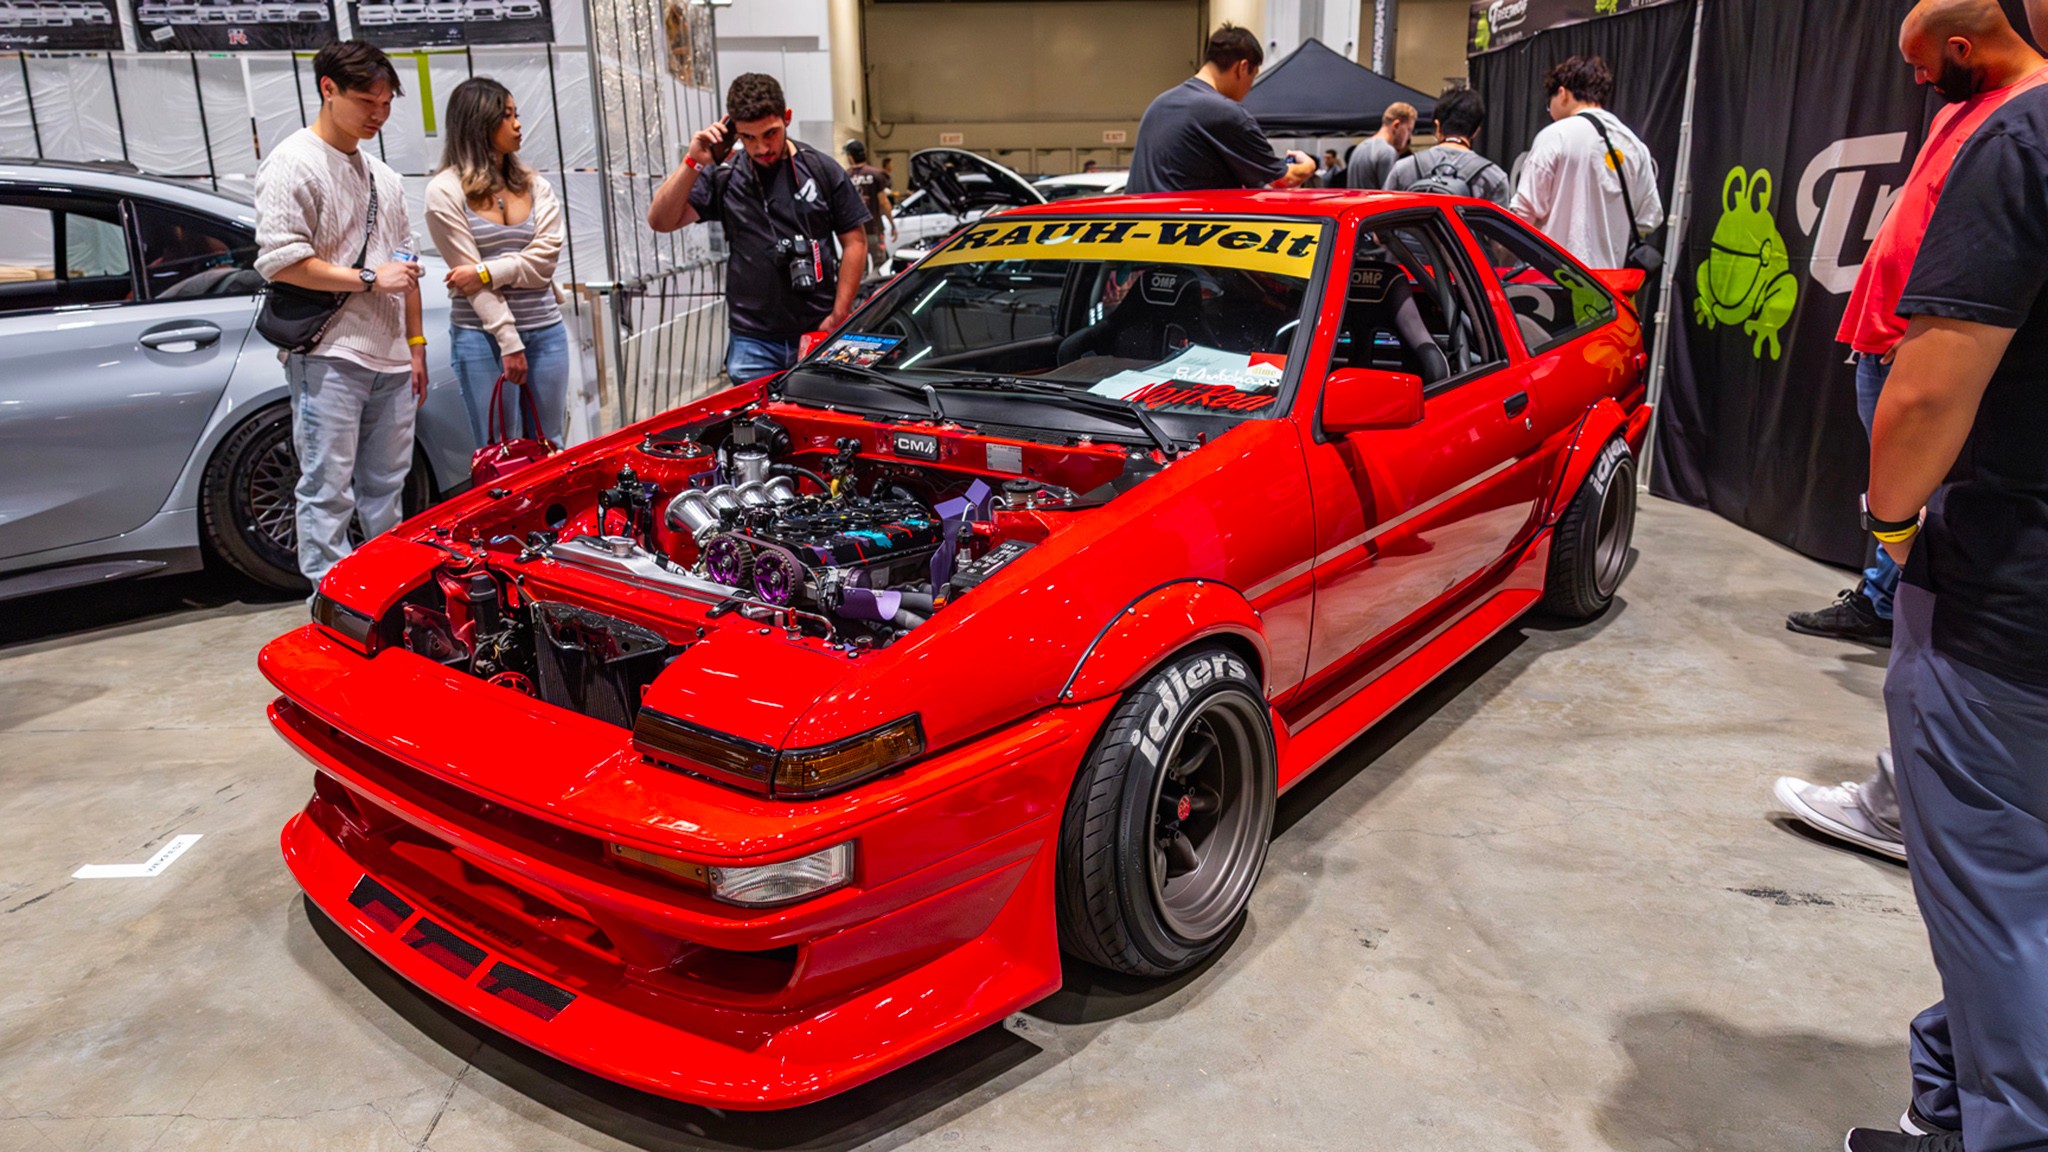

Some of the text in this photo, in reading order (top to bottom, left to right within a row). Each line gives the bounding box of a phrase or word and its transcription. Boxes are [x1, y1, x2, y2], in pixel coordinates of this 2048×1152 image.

[945, 222, 1318, 258] RAUH-Welt
[1151, 276, 1176, 288] OMP
[1352, 271, 1383, 285] OMP
[1130, 653, 1247, 768] idlers
